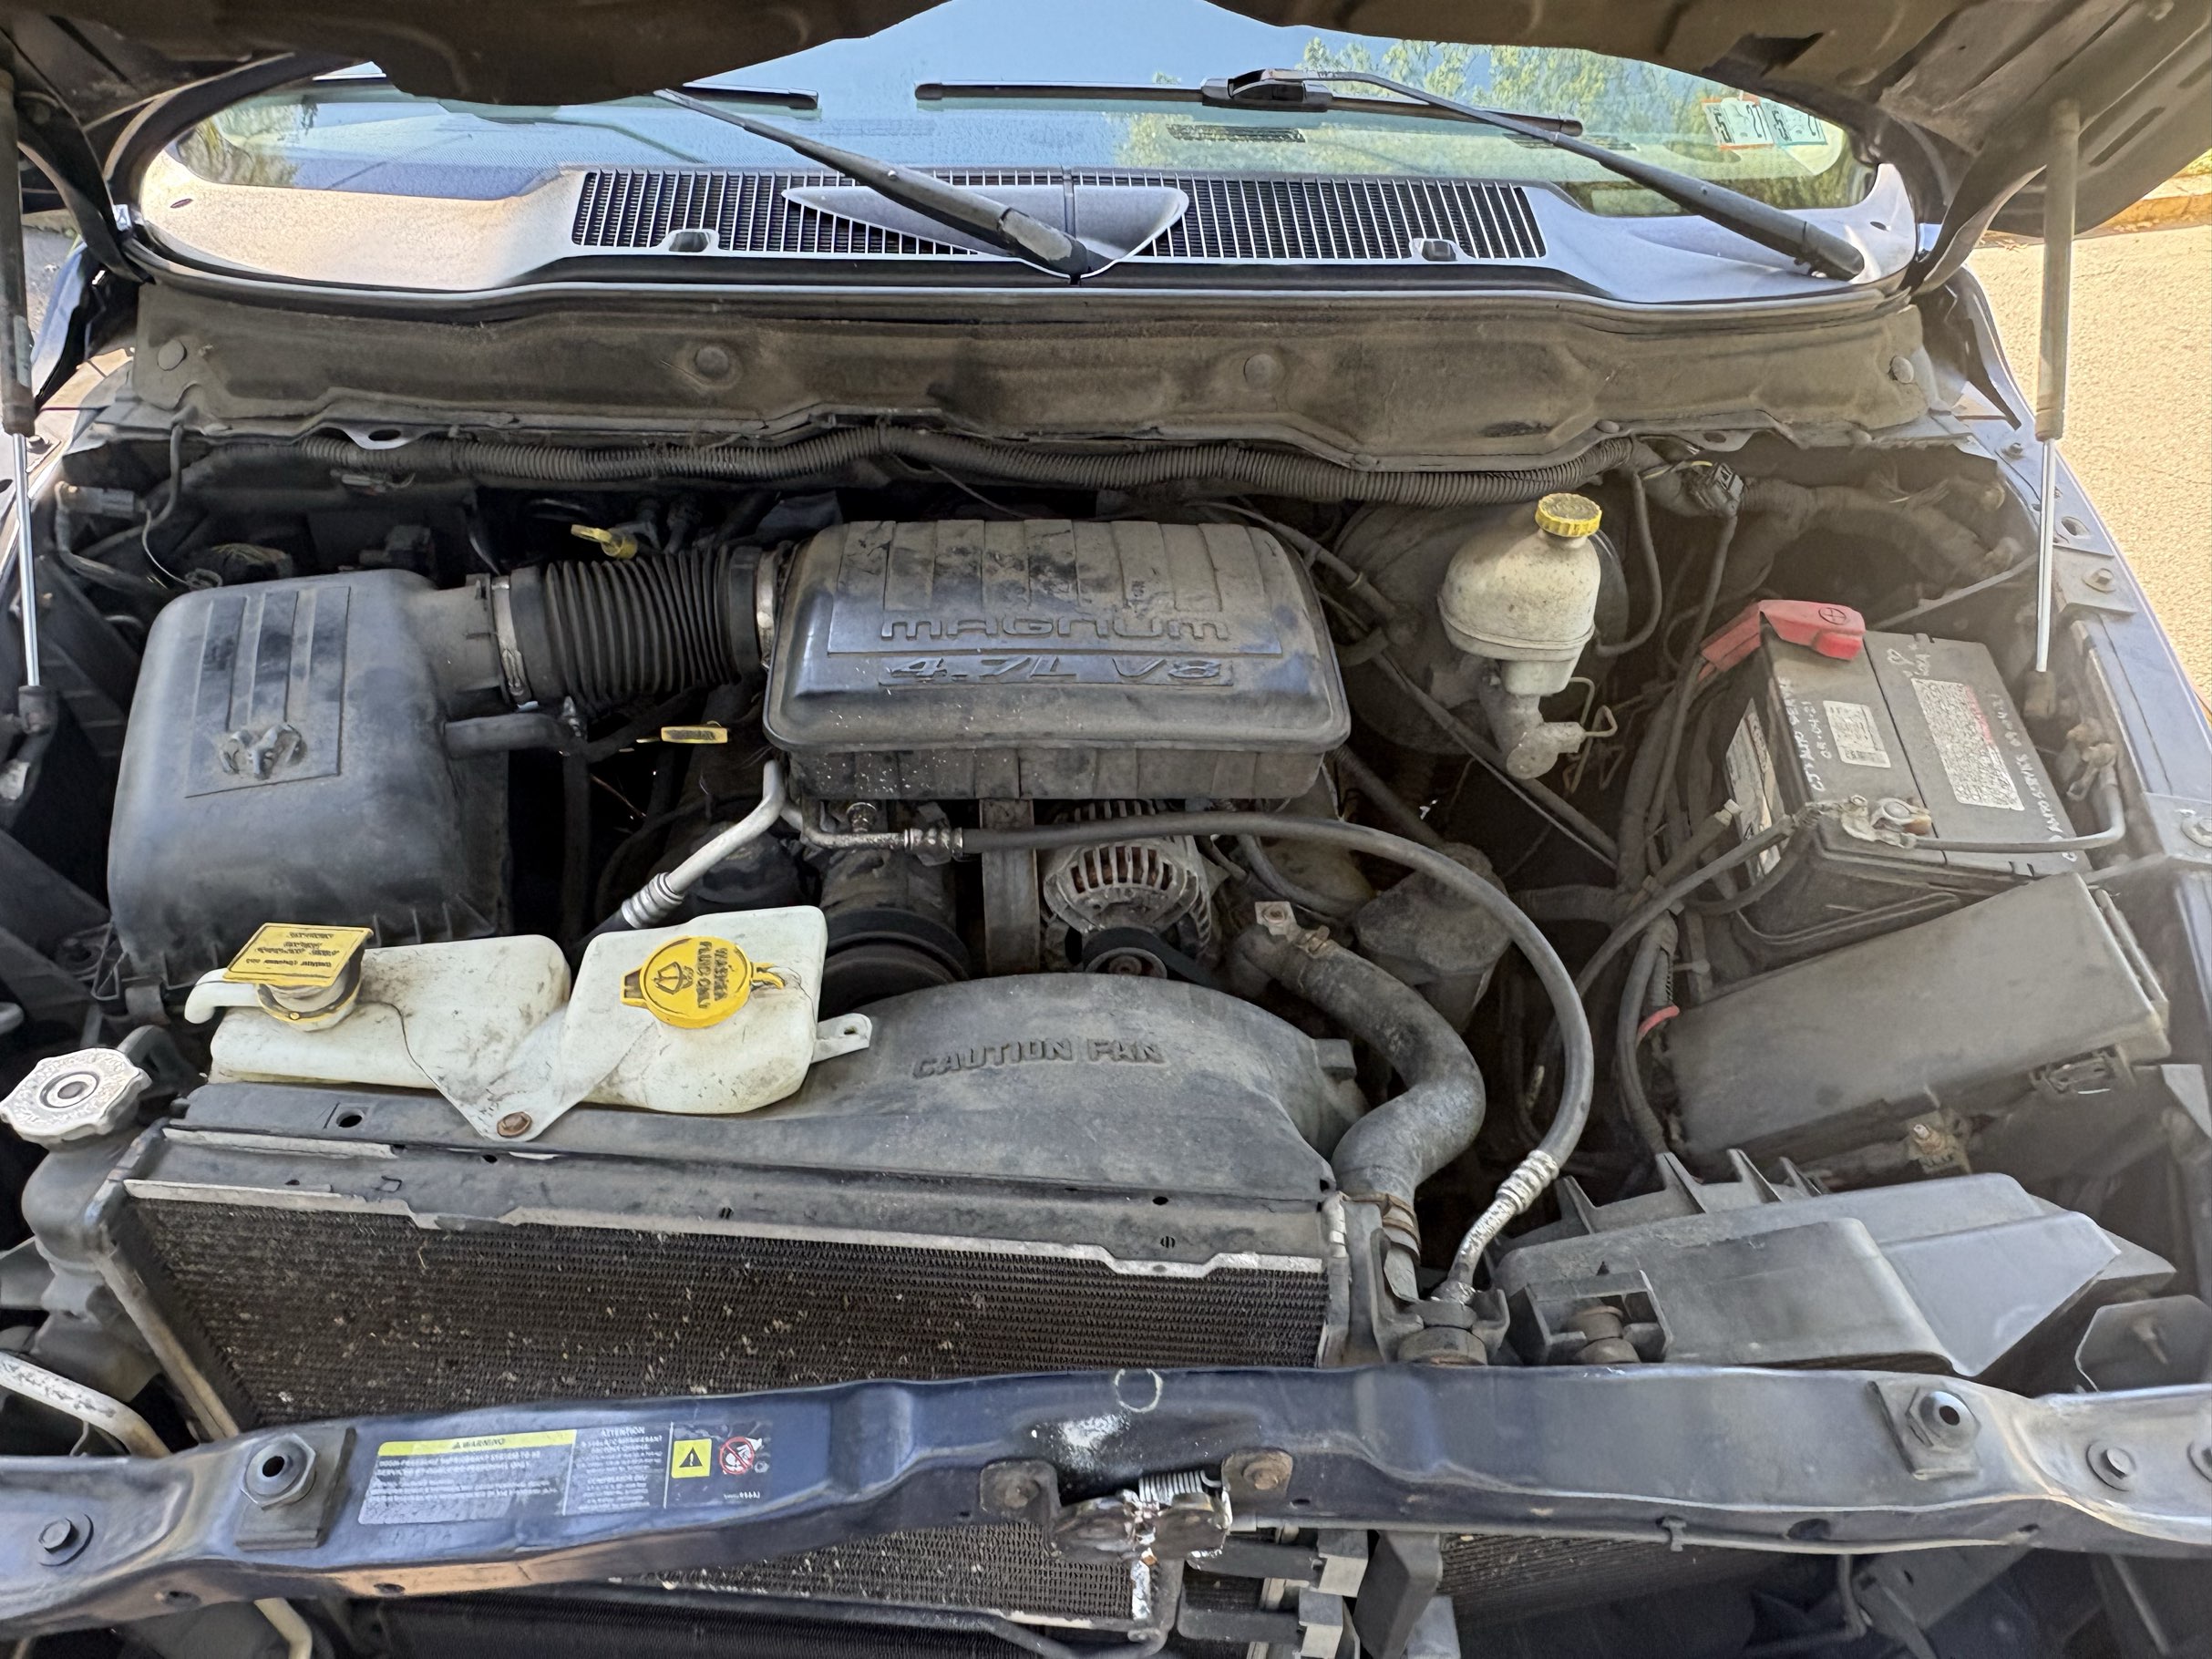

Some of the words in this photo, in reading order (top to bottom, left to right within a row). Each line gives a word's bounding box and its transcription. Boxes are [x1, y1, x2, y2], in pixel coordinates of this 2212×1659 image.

[880, 616, 1230, 641] MAGNUM
[890, 655, 1077, 681] 4.7L
[1113, 656, 1222, 681] V8
[912, 1037, 1074, 1079] CAUTION
[1086, 1037, 1168, 1065] FAN
